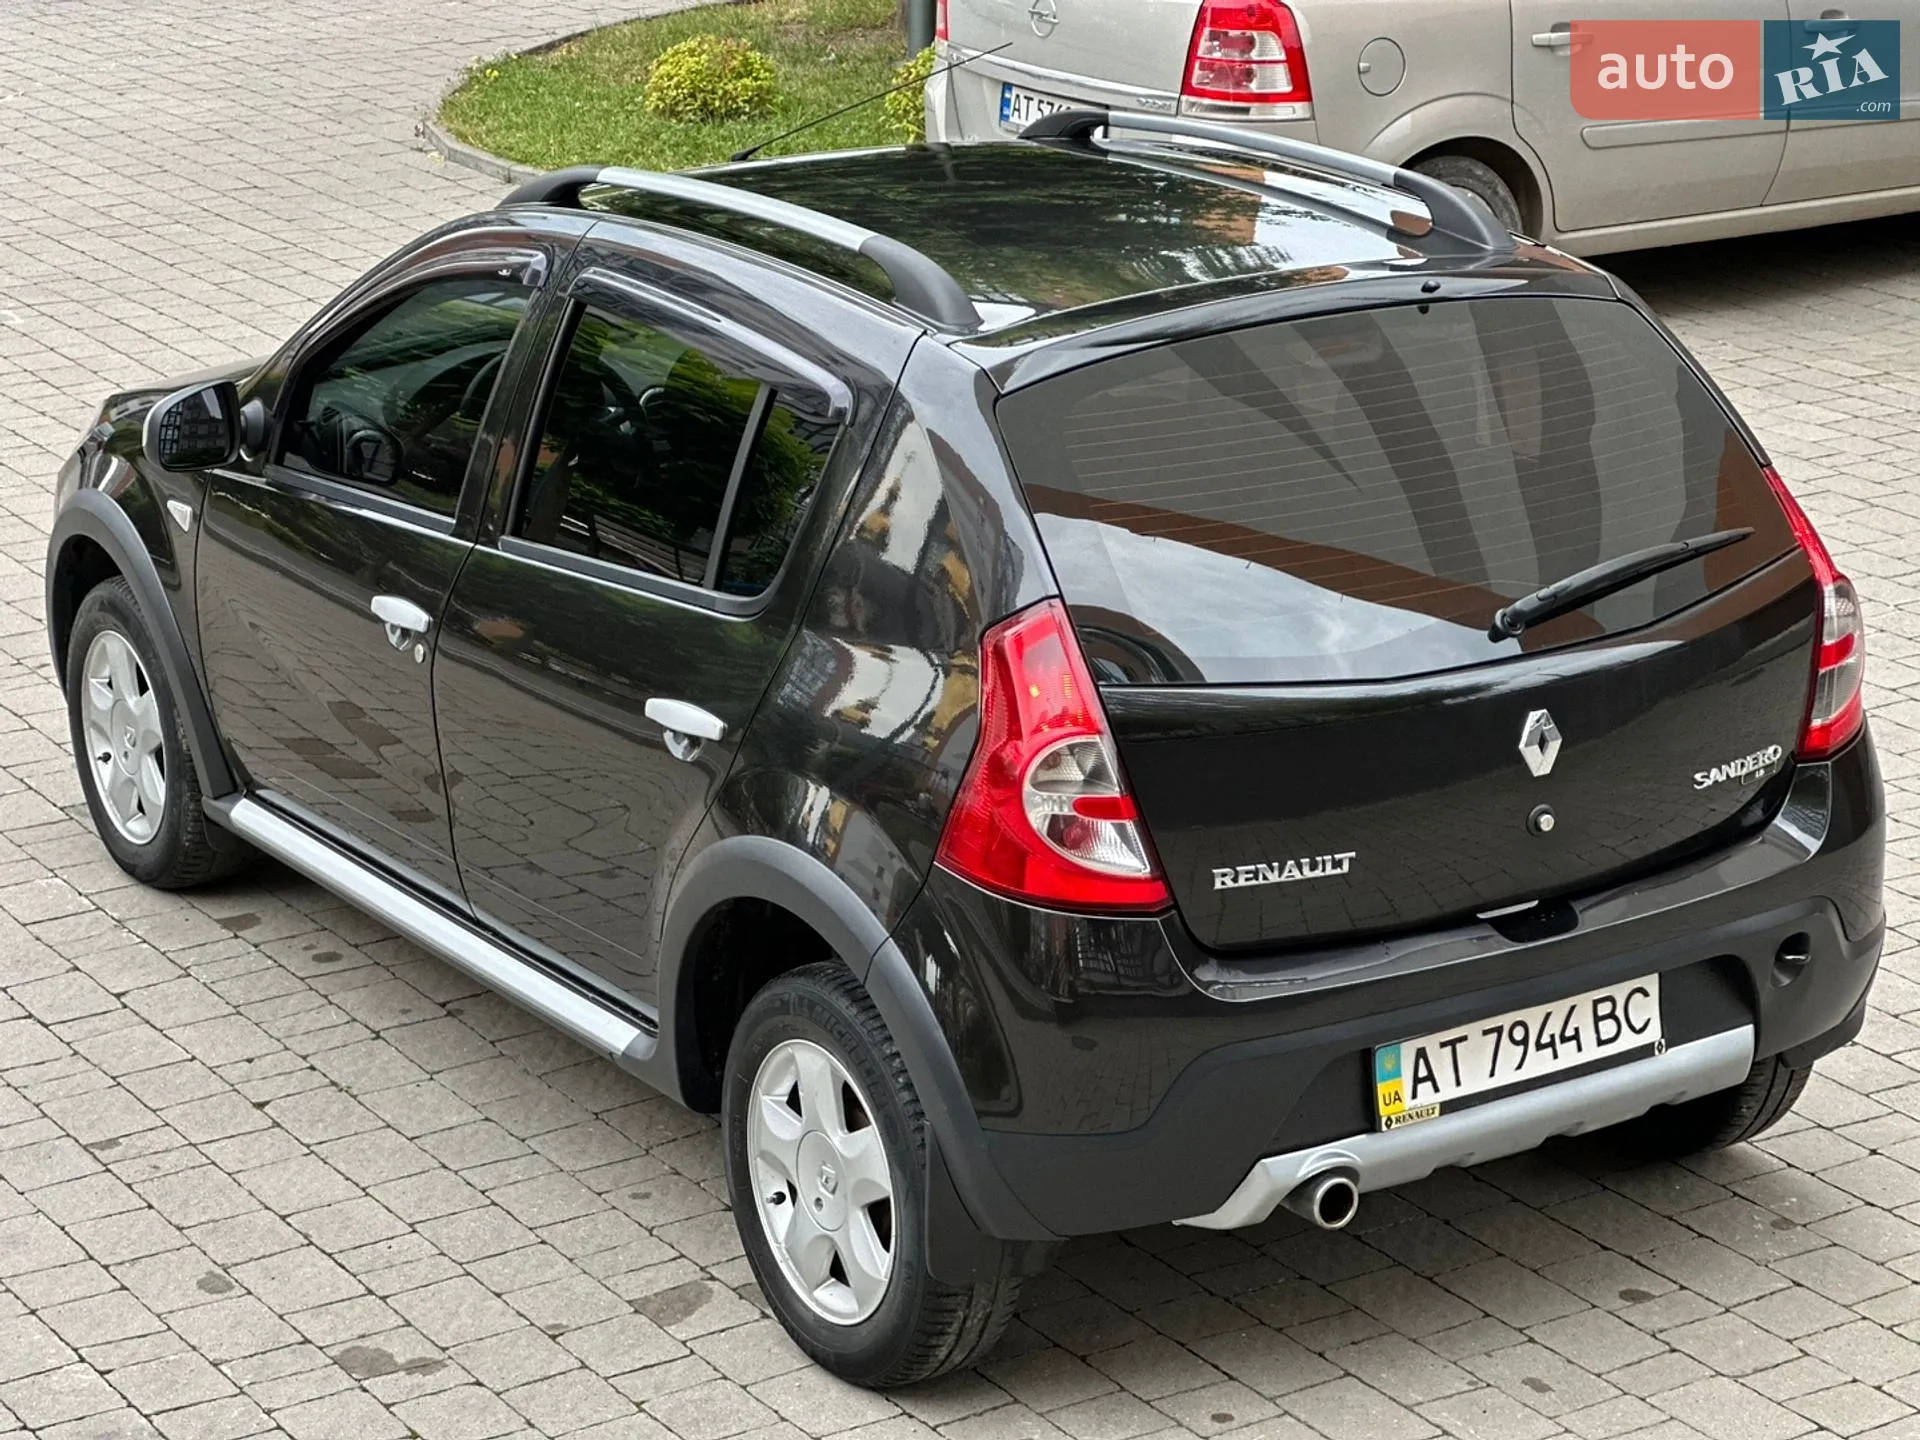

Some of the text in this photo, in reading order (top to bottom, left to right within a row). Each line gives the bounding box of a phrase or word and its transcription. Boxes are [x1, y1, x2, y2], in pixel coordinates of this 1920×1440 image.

[1012, 94, 1034, 121] AT
[1037, 99, 1072, 119] 57
[1693, 744, 1782, 789] SANDERO
[1212, 851, 1356, 890] RENAULT
[1410, 986, 1652, 1100] AT 7944 BC
[1382, 1089, 1403, 1107] UA
[1394, 1106, 1437, 1125] RENAULT
